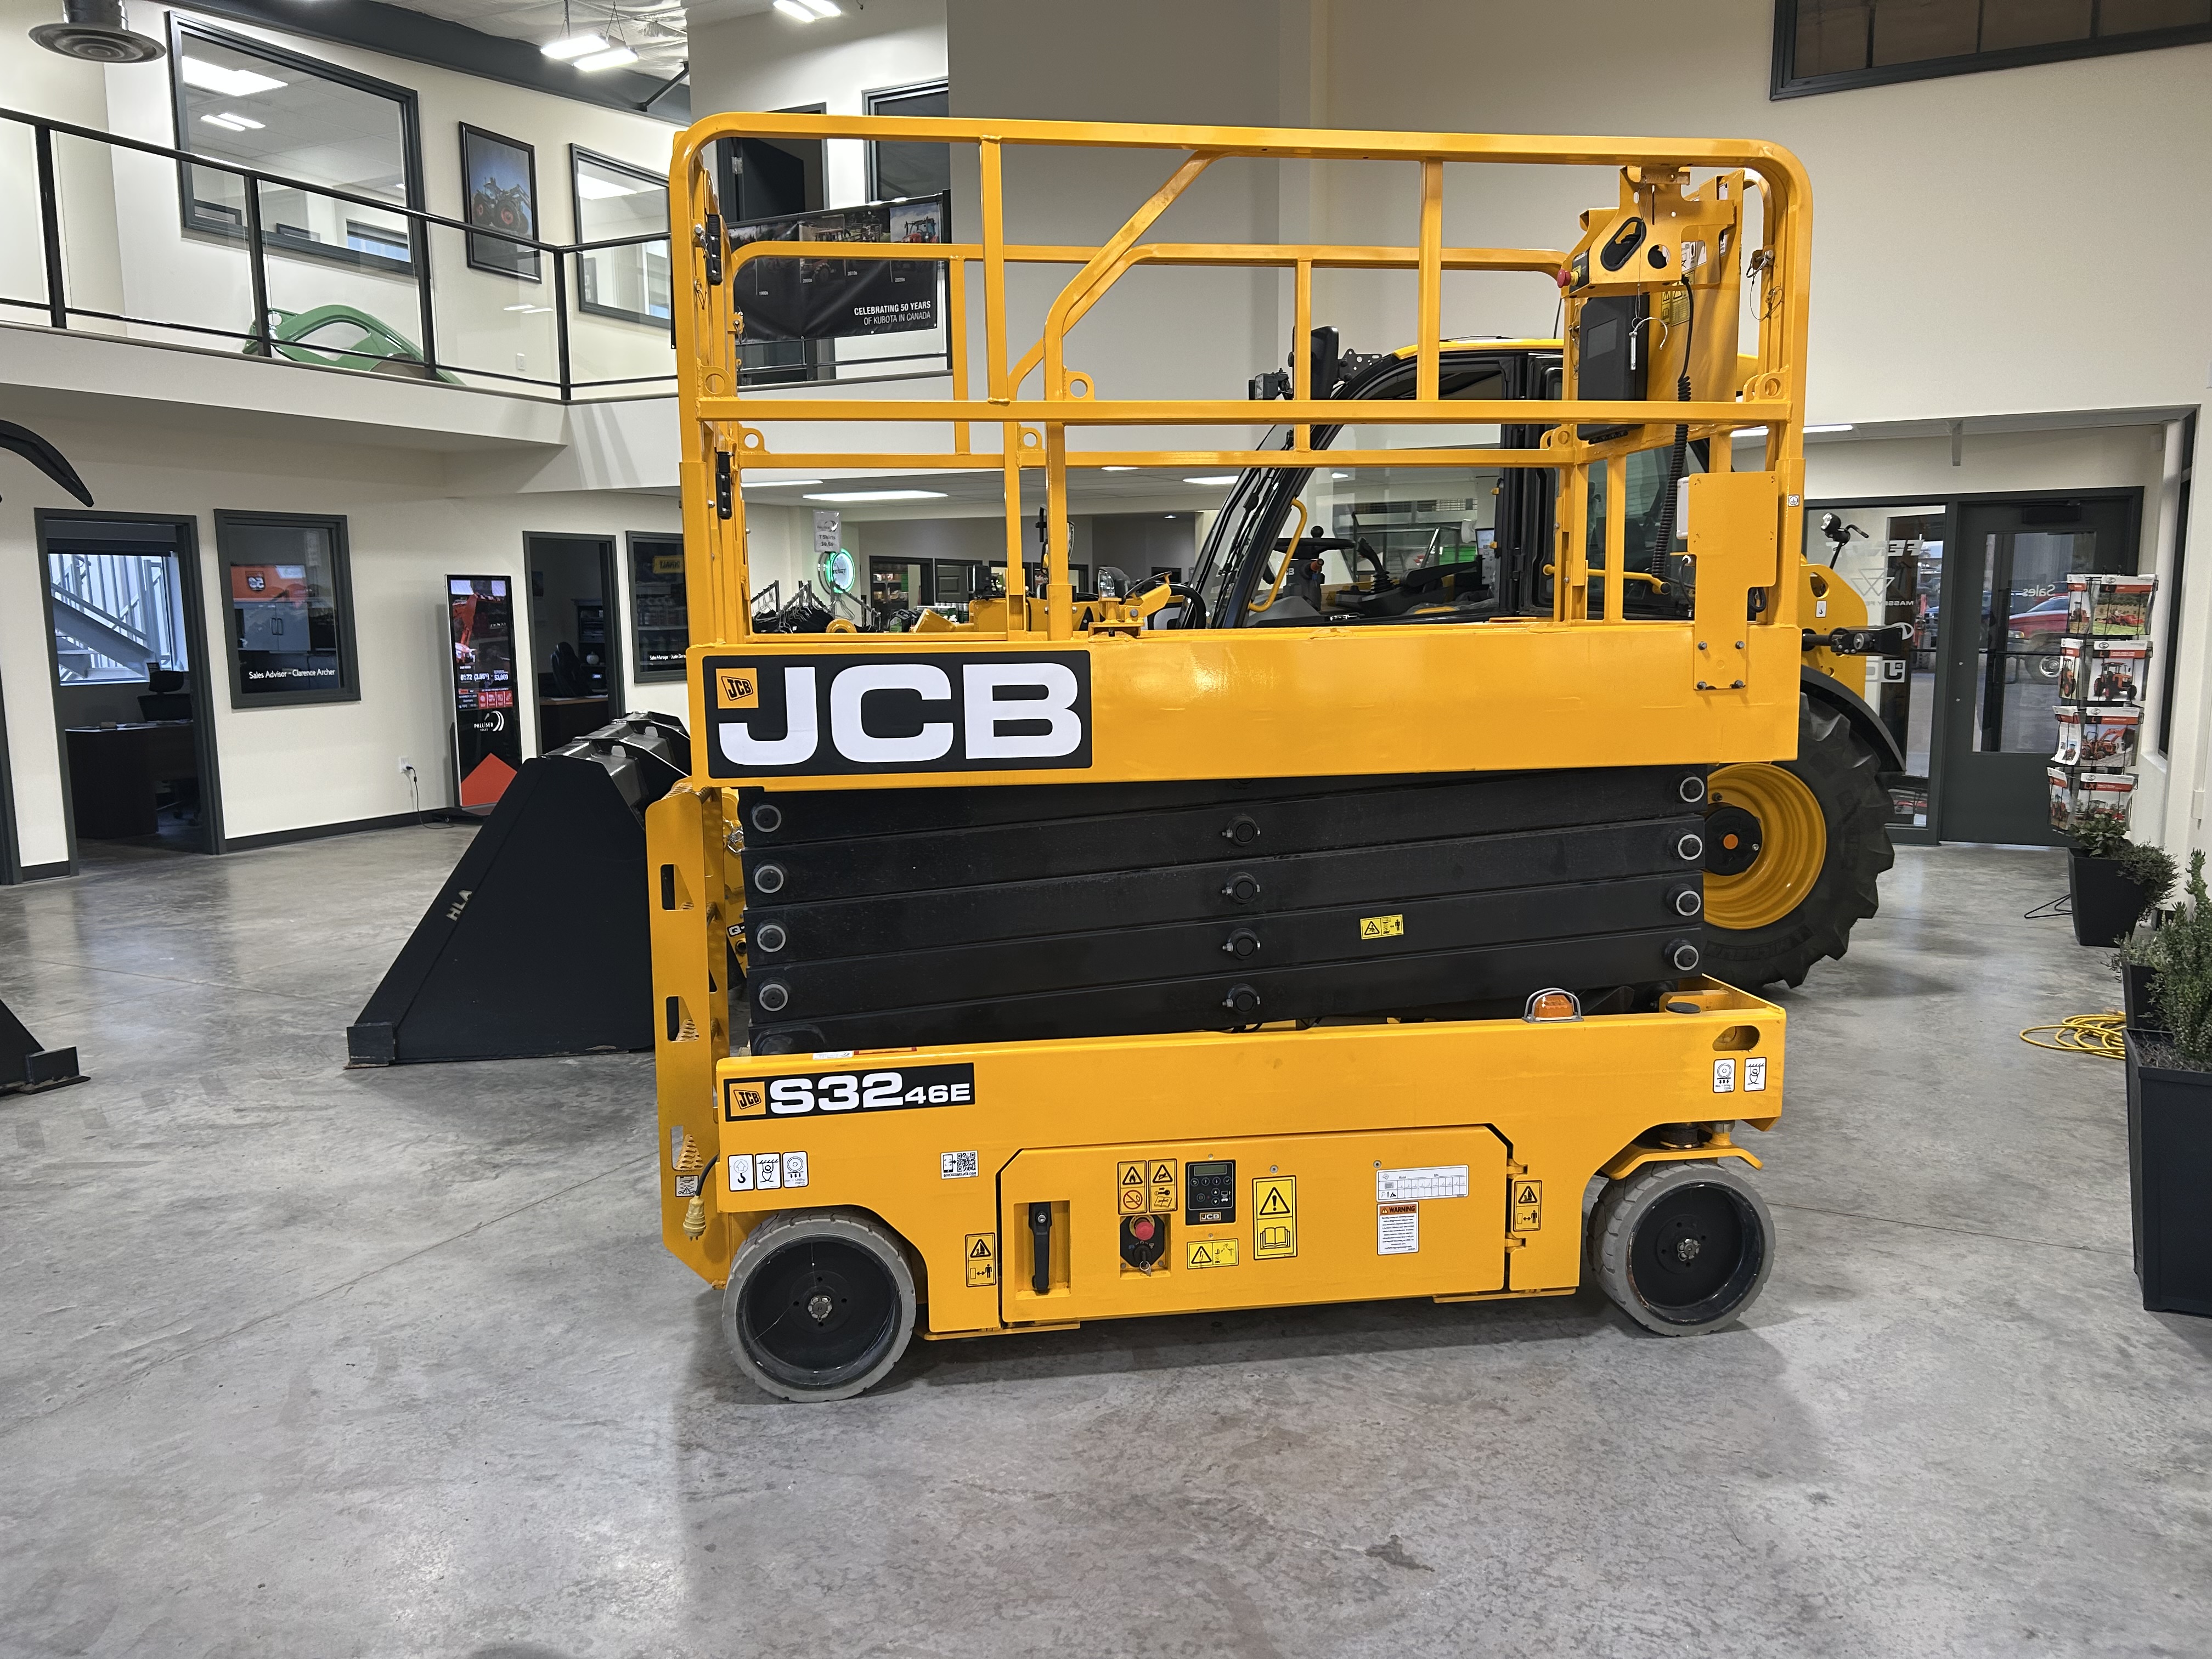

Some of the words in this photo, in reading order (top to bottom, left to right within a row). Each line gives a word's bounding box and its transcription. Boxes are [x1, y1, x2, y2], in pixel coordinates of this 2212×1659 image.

[854, 304, 899, 315] CELEBRATING
[900, 303, 909, 311] 50
[910, 300, 931, 311] YEARS
[864, 317, 872, 325] OF
[873, 315, 898, 325] KUBOTA
[899, 314, 905, 322] IN
[906, 311, 931, 321] CANADA
[249, 671, 264, 679] Sales
[292, 669, 315, 677] Clarence
[727, 678, 752, 697] JCB
[718, 663, 1082, 766] JCB
[445, 890, 473, 921] HLA
[737, 1091, 760, 1108] JCB
[1389, 1205, 1415, 1214] WARNING
